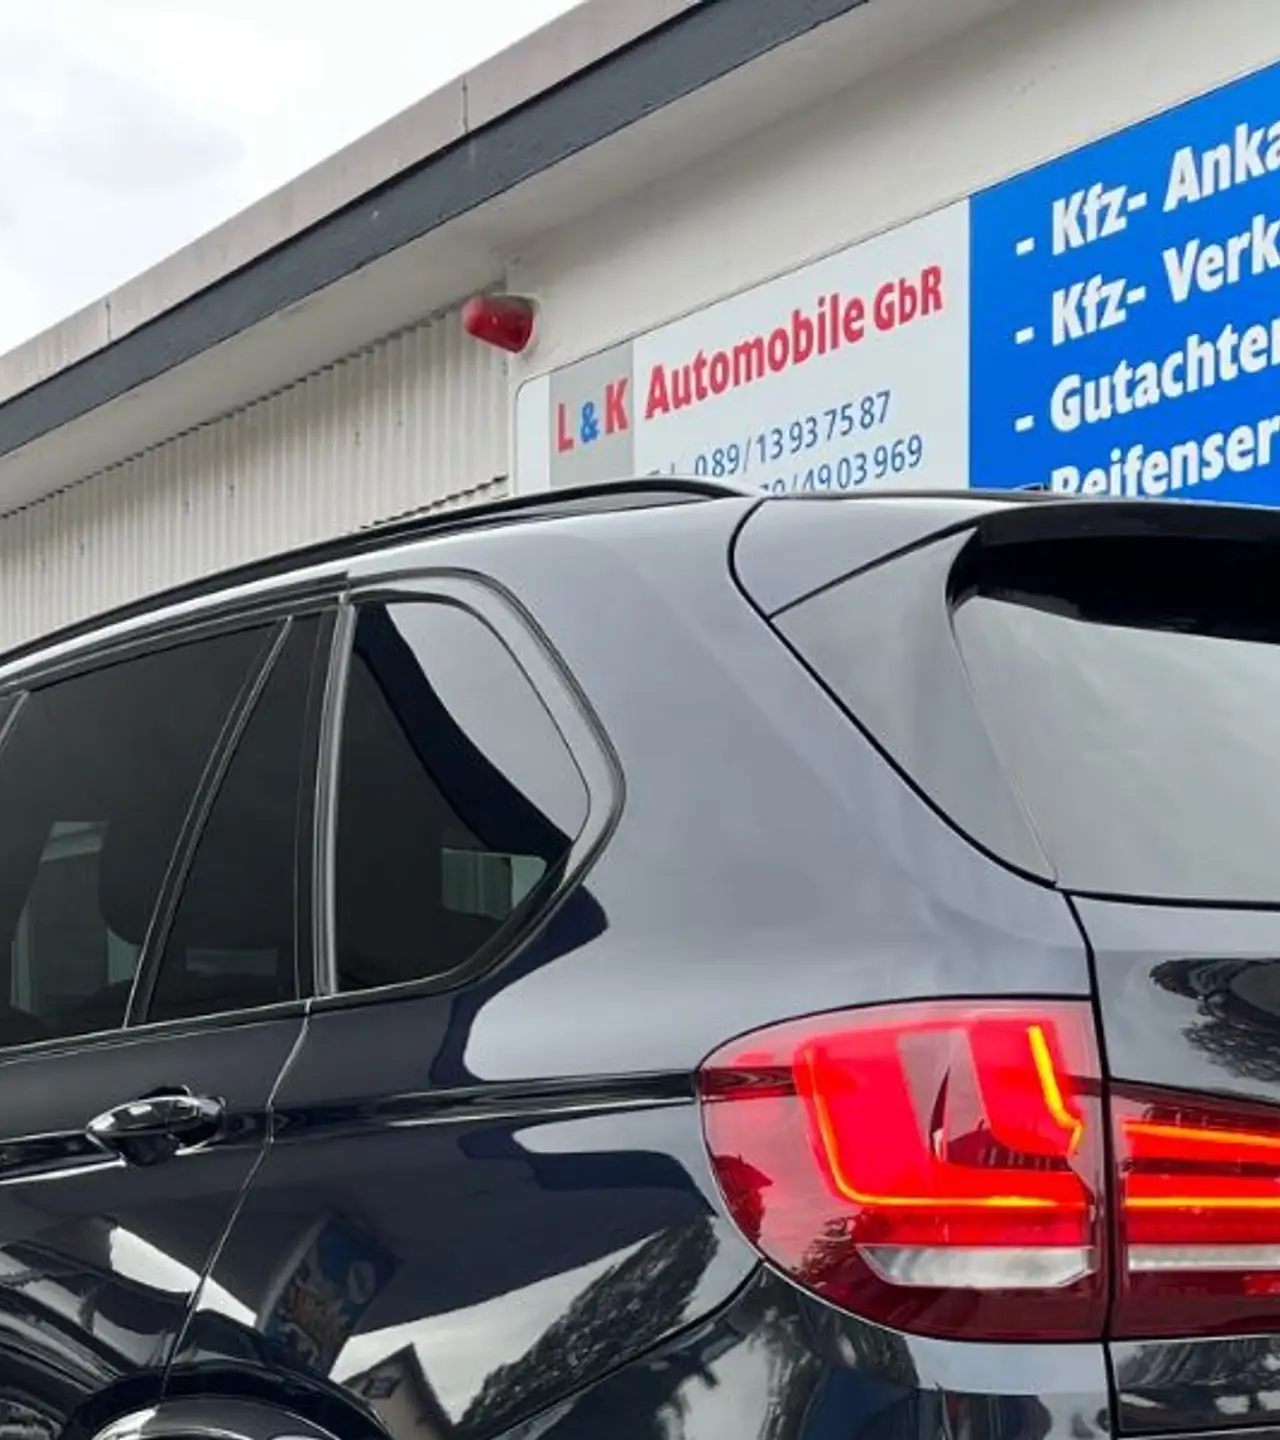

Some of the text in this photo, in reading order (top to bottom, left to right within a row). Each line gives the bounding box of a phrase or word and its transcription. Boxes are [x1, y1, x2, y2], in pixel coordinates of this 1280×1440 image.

[1051, 183, 1148, 255] Kfz-
[645, 293, 866, 420] Automobile
[873, 265, 944, 332] GbR
[1051, 274, 1147, 345] Kfz-
